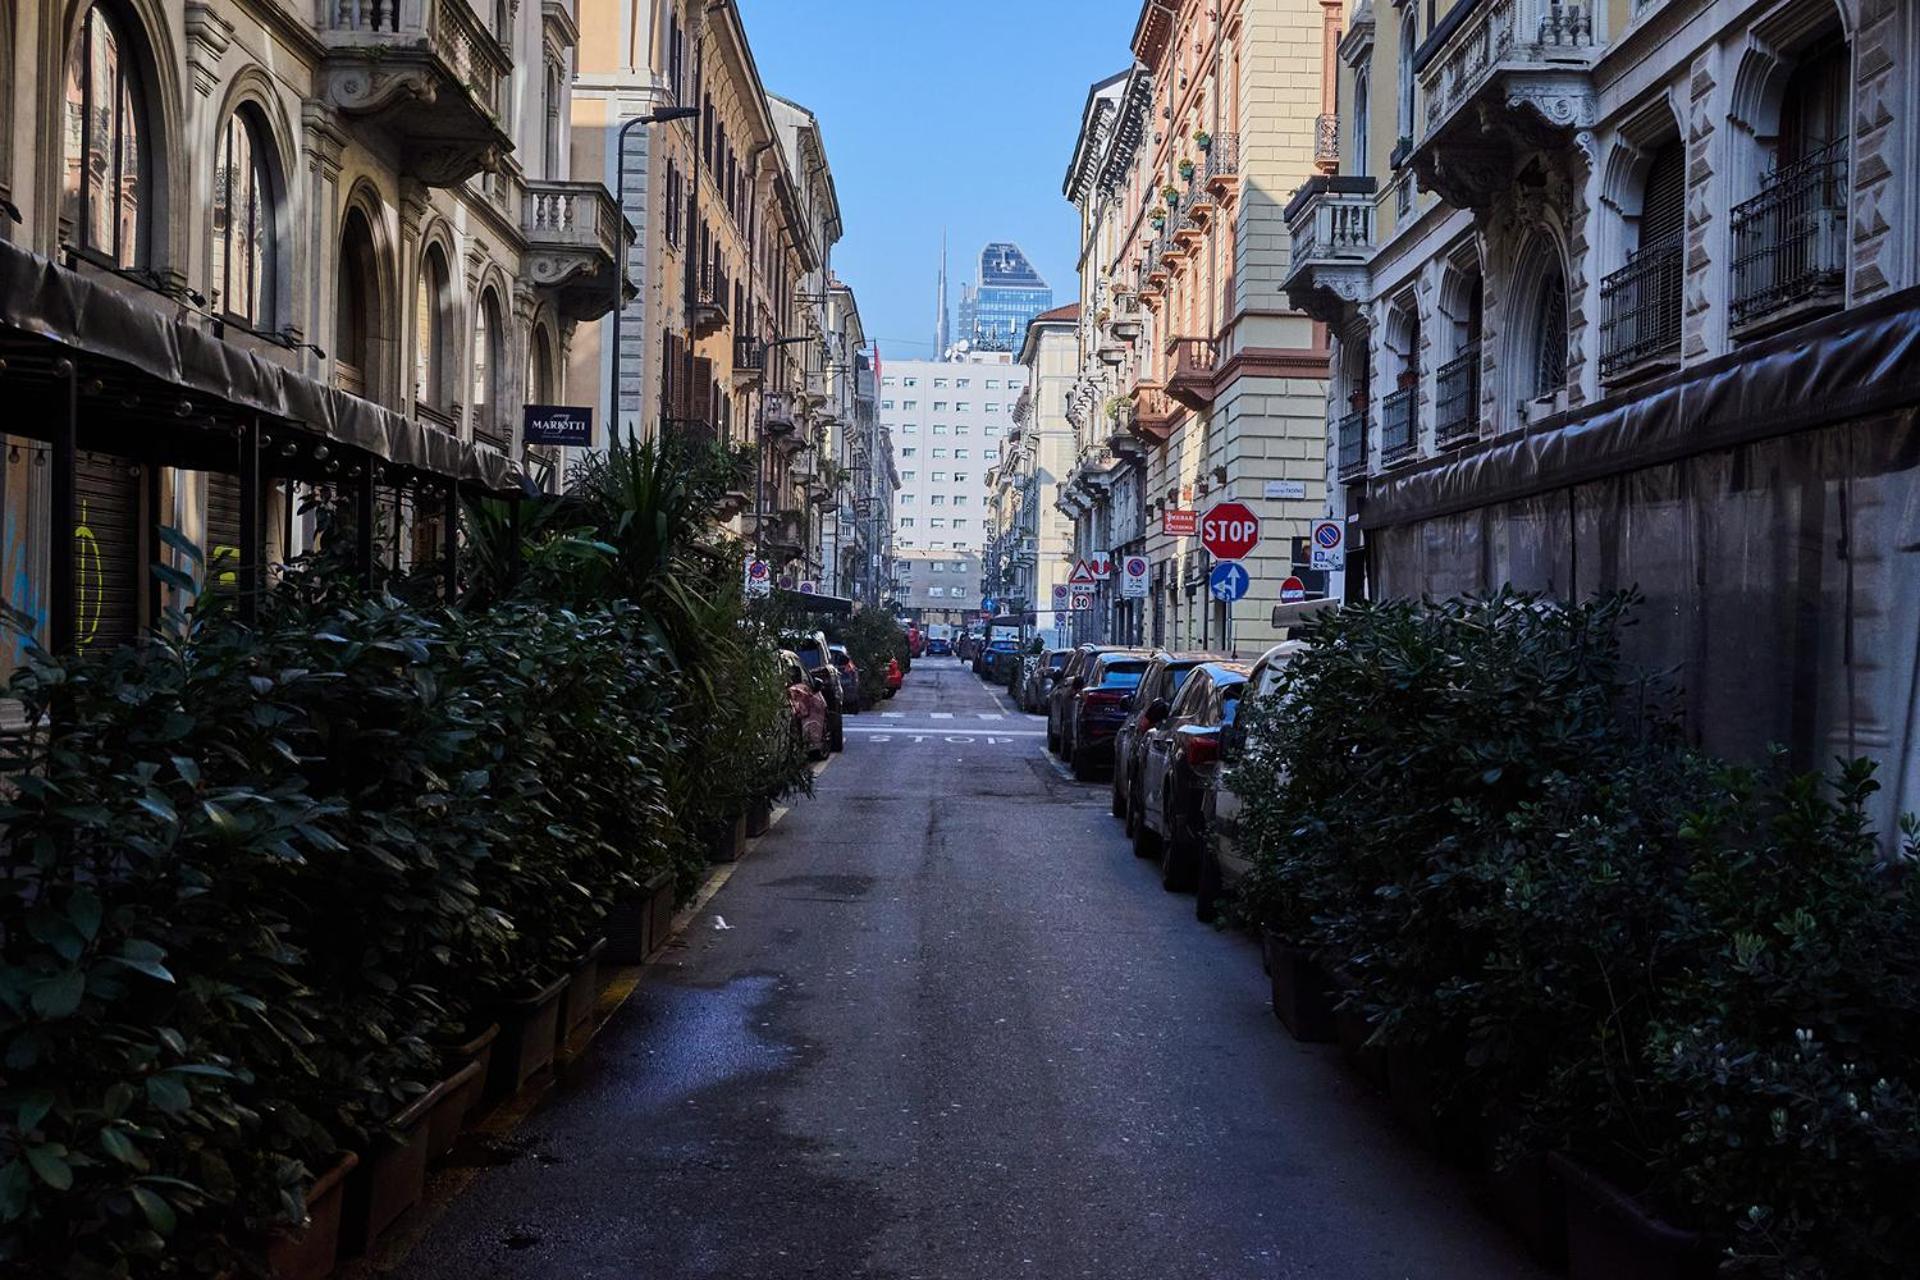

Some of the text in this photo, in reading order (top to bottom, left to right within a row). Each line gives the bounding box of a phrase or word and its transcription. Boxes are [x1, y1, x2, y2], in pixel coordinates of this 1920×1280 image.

[531, 420, 585, 431] MARIOTTI
[1204, 520, 1256, 543] STOP
[1076, 598, 1087, 608] 30
[868, 735, 1015, 744] STOP
